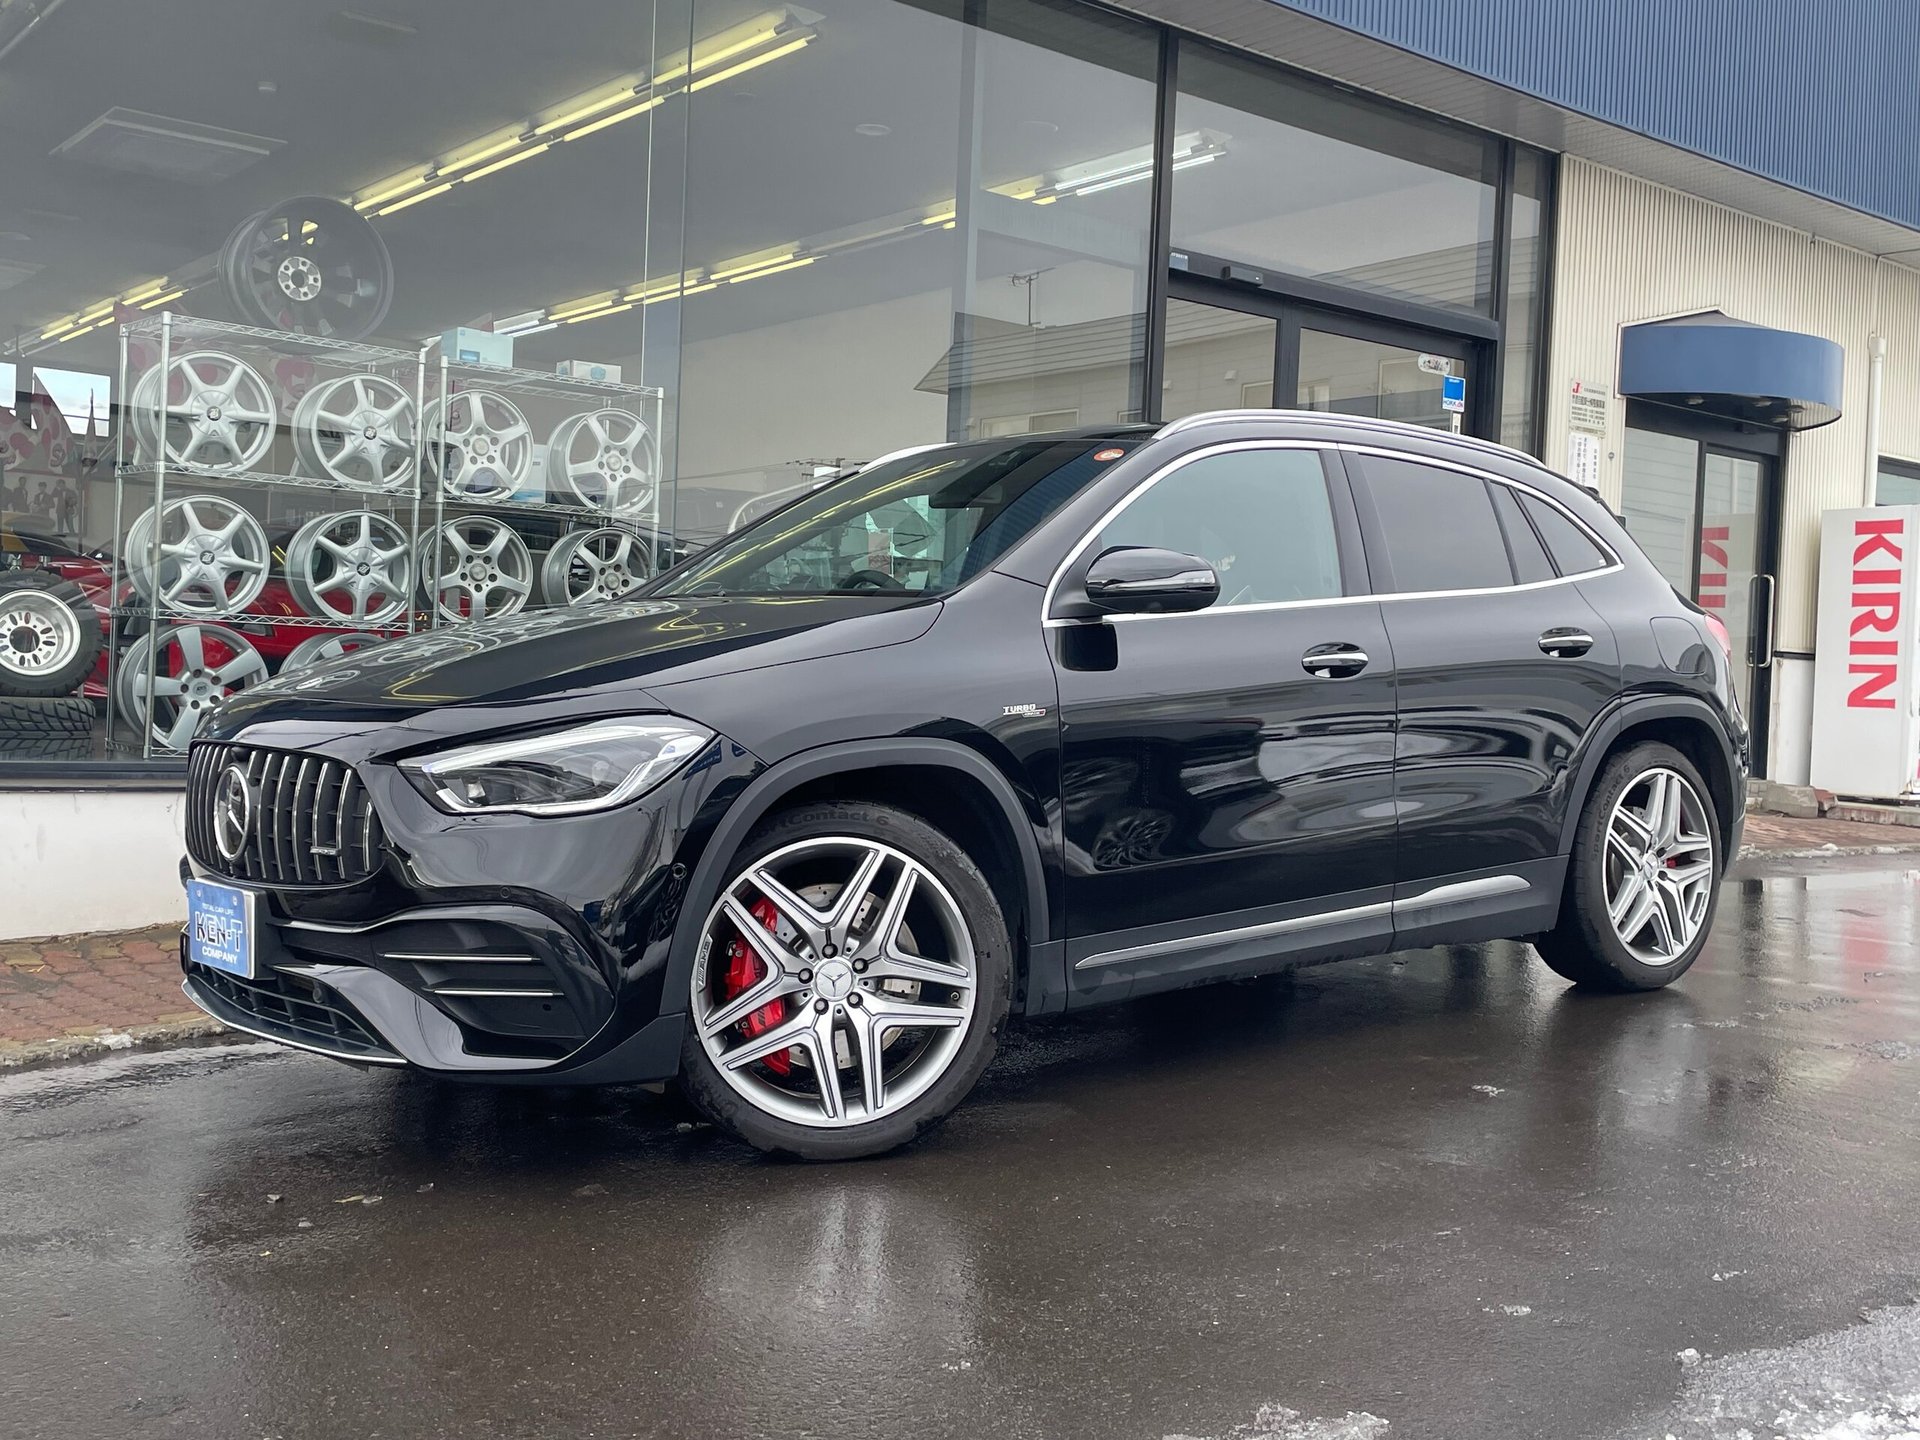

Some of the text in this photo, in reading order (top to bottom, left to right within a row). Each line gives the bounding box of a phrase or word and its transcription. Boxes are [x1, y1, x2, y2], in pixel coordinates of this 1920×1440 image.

[1847, 518, 1904, 709] KIRIN
[1003, 703, 1036, 716] TURBO
[876, 814, 889, 827] 6
[202, 945, 238, 964] COMPANY
